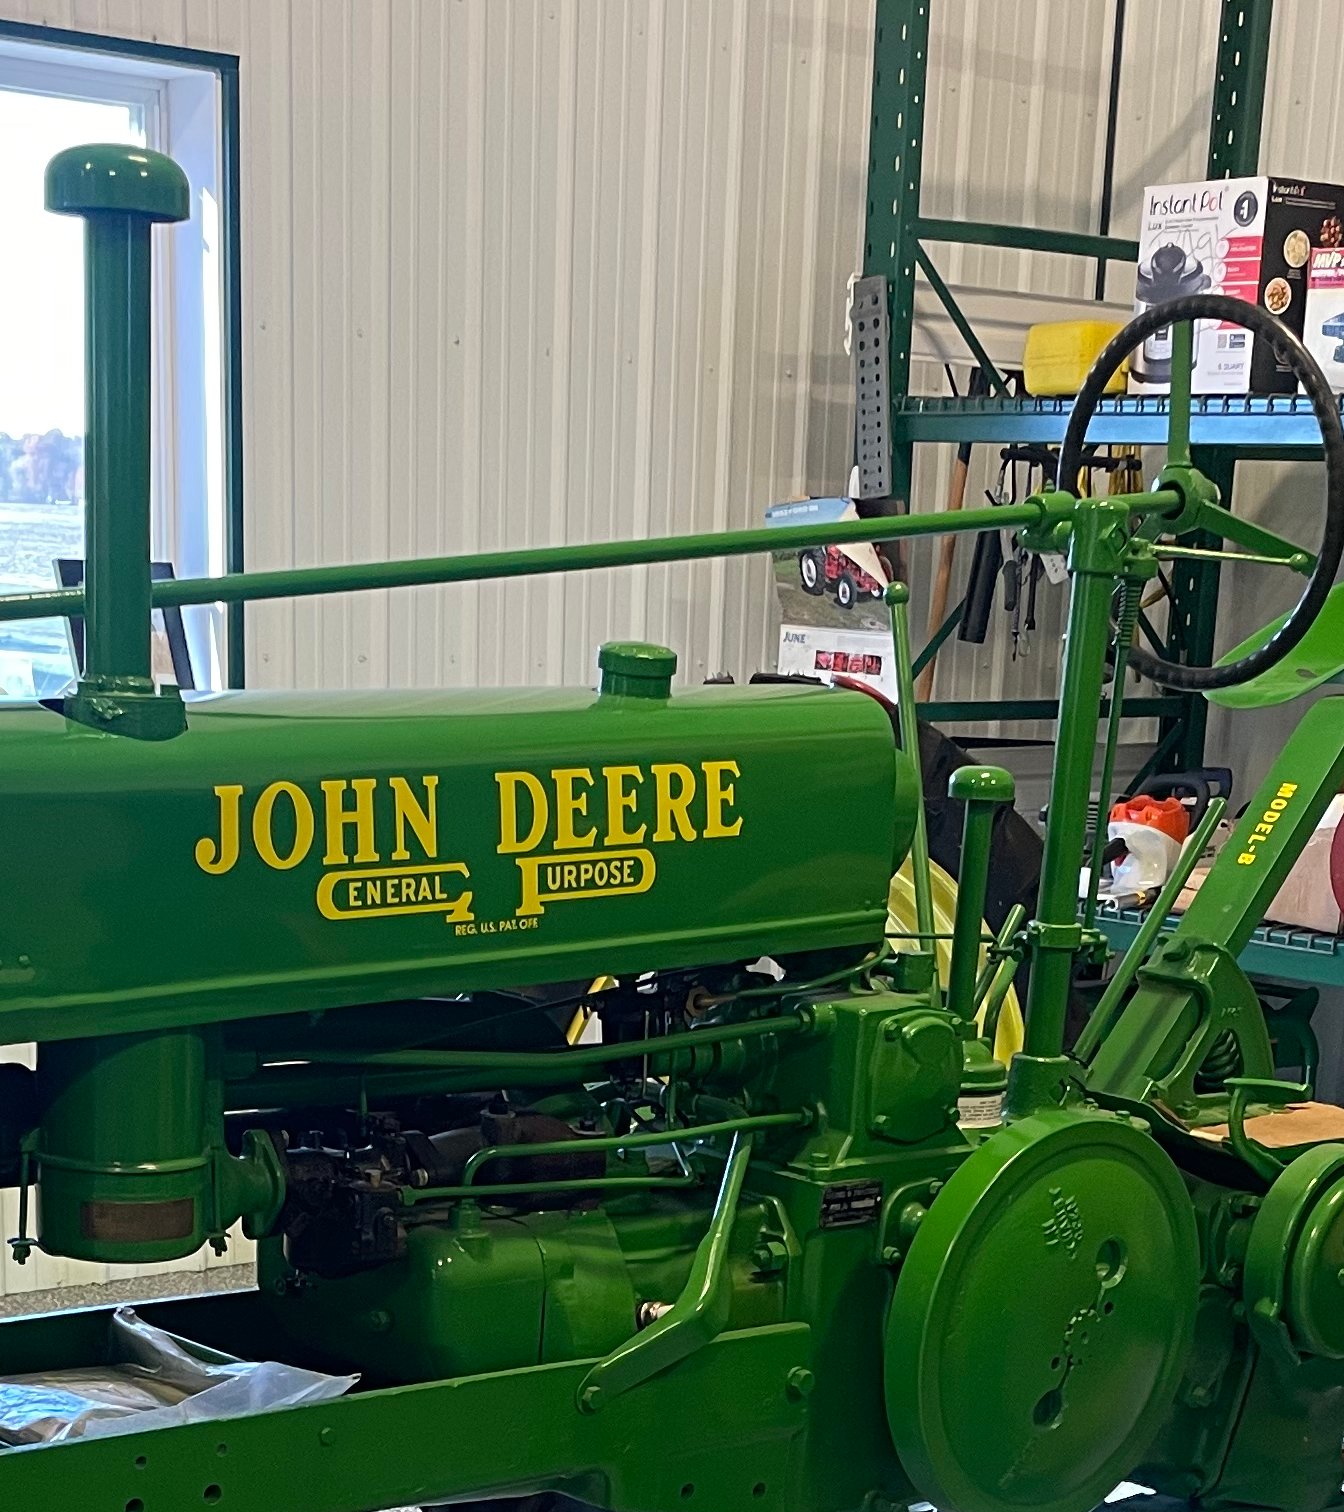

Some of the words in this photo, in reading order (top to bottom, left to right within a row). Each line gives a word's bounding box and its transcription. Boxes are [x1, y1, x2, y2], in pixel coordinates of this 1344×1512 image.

[1149, 194, 1197, 216] Instant
[1199, 190, 1223, 212] Pot
[1312, 251, 1342, 268] MVP
[782, 631, 806, 644] JUNE
[194, 775, 440, 875] JOHN
[495, 760, 744, 855] DEERE
[1237, 782, 1298, 865] MODEL-B
[455, 923, 478, 936] REG.
